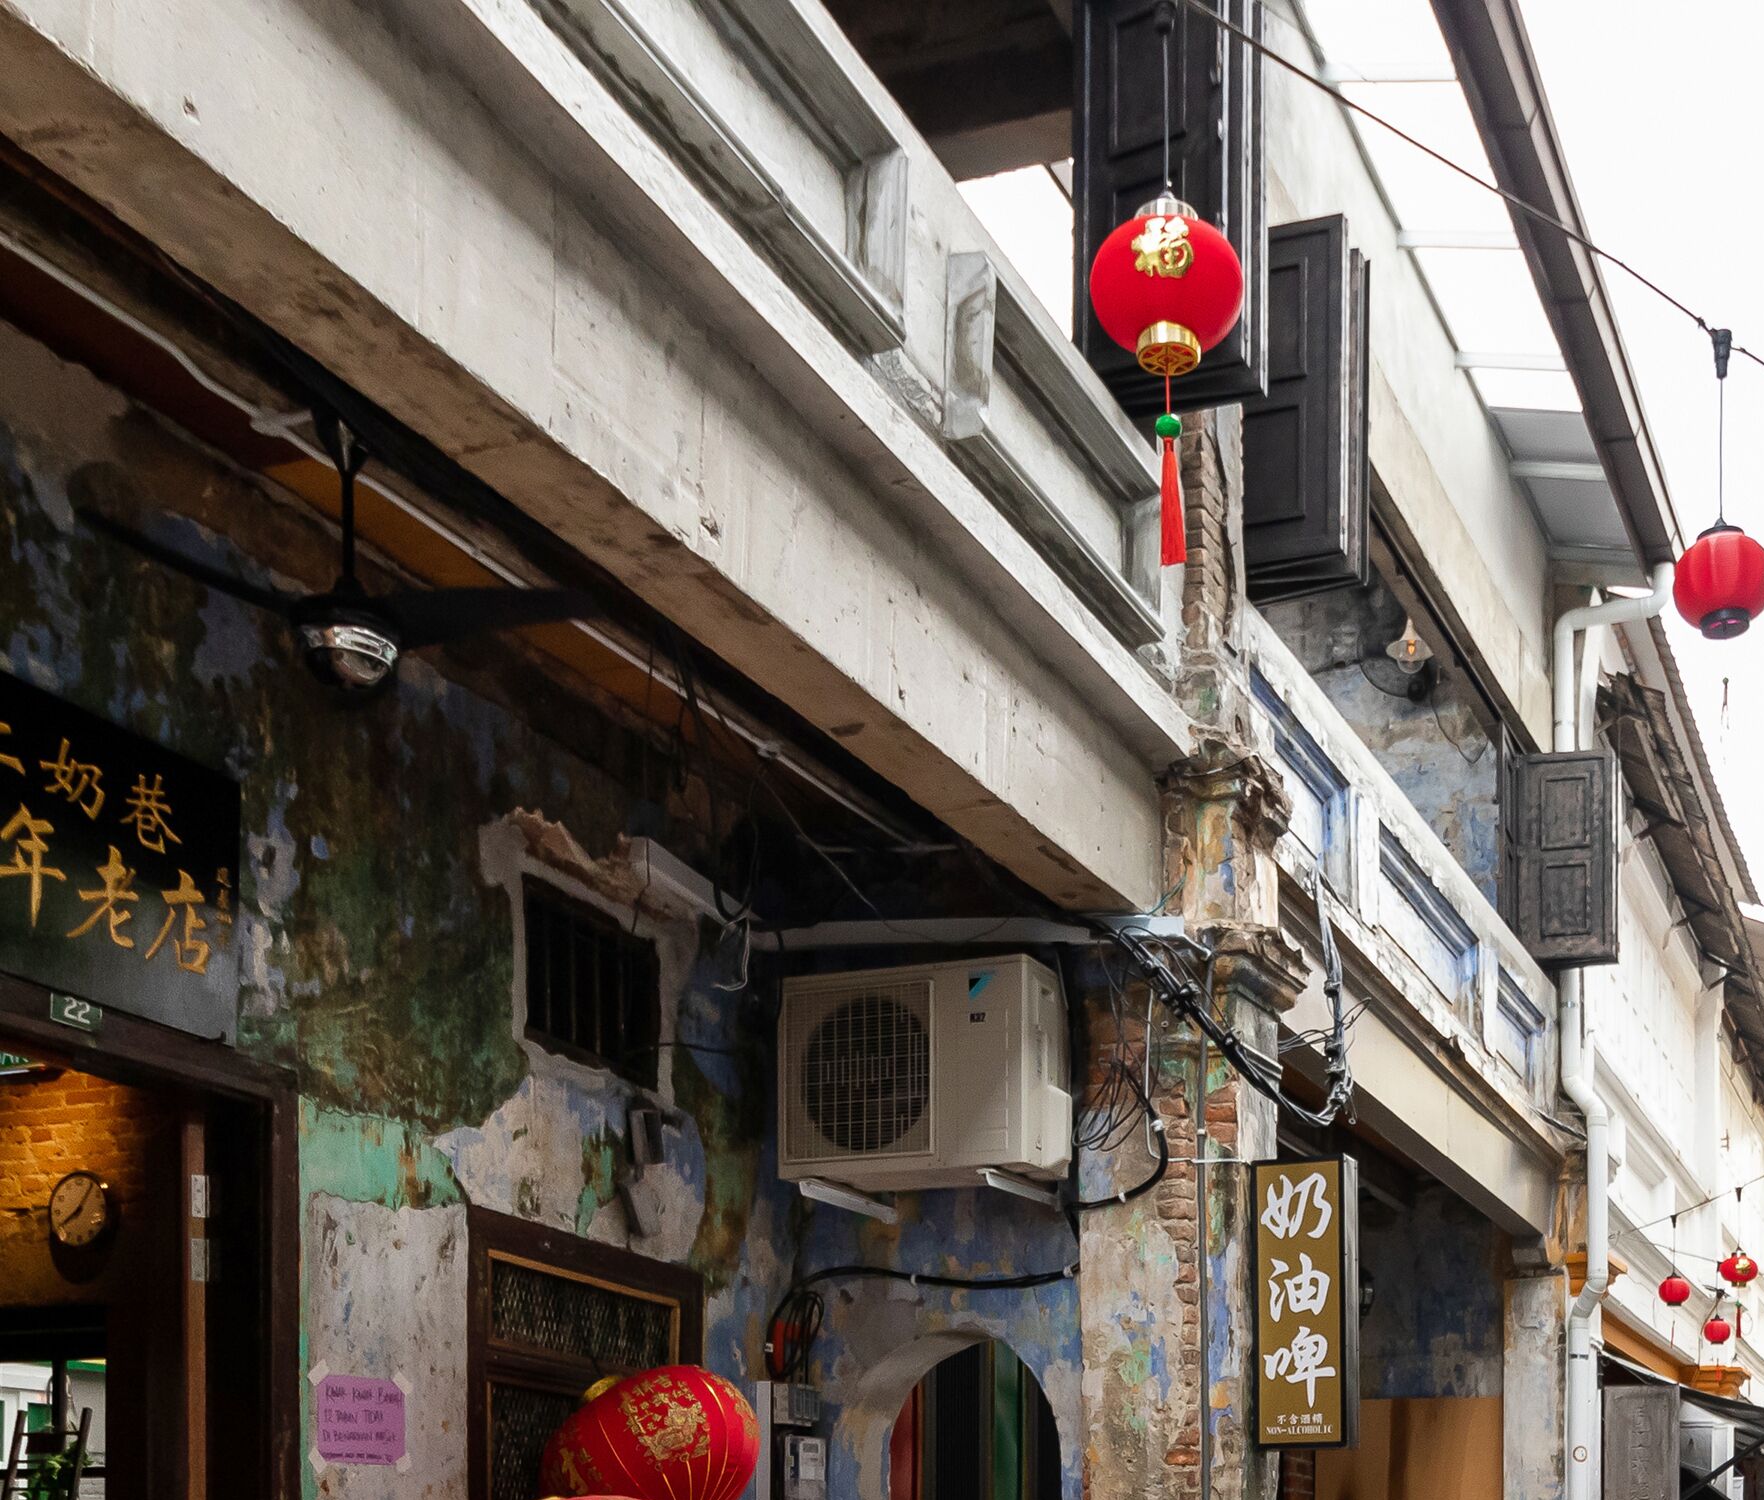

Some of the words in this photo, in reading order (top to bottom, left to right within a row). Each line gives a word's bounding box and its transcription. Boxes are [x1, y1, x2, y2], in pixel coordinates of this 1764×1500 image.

[1131, 216, 1195, 279] 福
[64, 997, 91, 1024] 22
[1261, 1172, 1337, 1408] 奶油啤
[1266, 1425, 1334, 1435] NON-ALCOHOLIC
